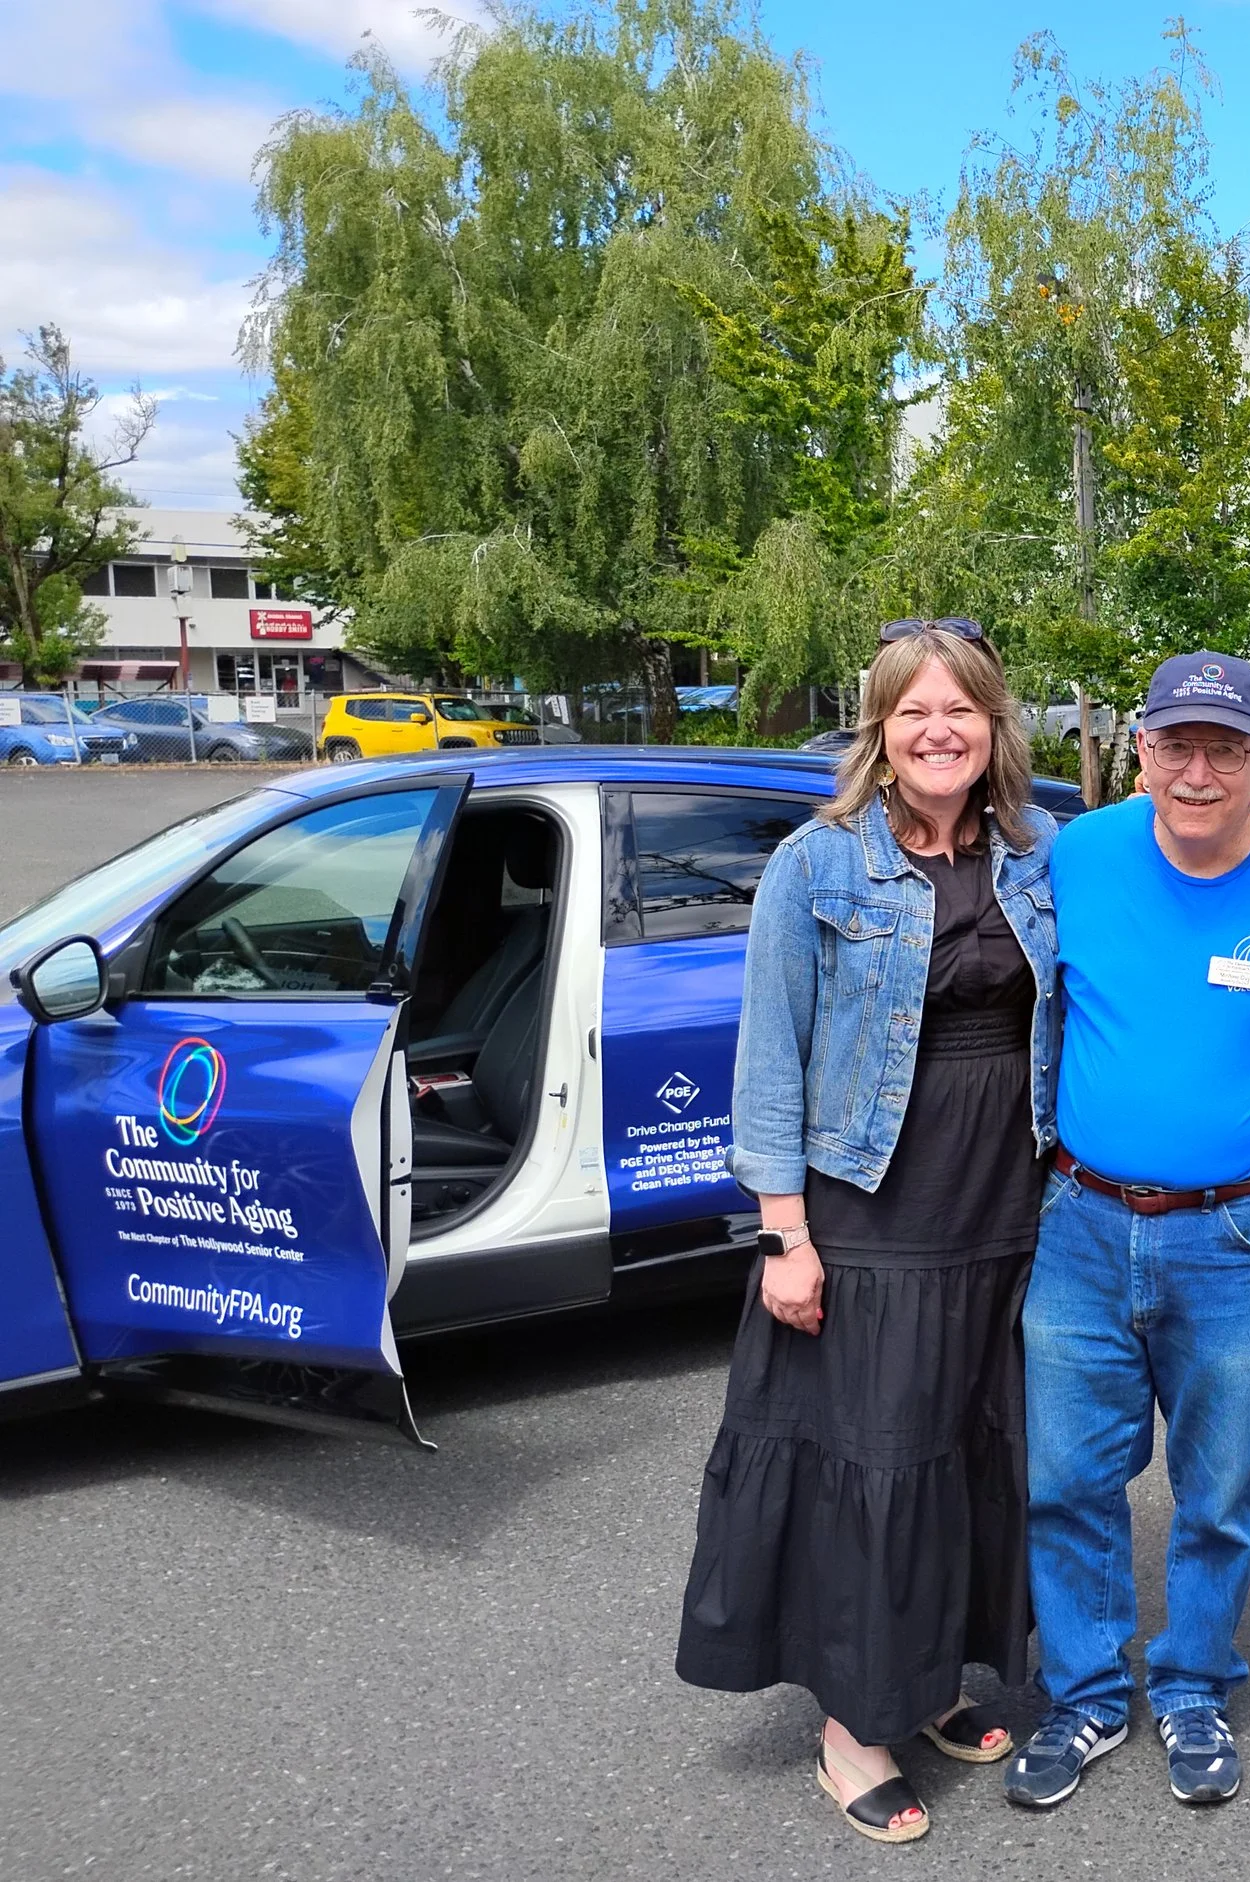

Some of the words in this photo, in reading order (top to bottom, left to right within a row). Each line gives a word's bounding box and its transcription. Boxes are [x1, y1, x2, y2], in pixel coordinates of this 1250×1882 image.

[1182, 680, 1224, 691] Community
[1223, 683, 1234, 692] for
[1188, 674, 1203, 682] The
[1192, 686, 1222, 696] Positive
[1222, 691, 1243, 703] Aging
[665, 1086, 692, 1099] PGE
[115, 1115, 159, 1148] The
[627, 1125, 658, 1138] Drive
[658, 1119, 702, 1133] Change
[703, 1114, 730, 1128] Fund
[640, 1139, 685, 1154] Powered
[688, 1137, 701, 1149] by
[702, 1135, 720, 1145] the
[620, 1157, 643, 1168] PGE
[645, 1153, 673, 1166] Drive
[675, 1149, 714, 1162] Change
[716, 1145, 728, 1155] Fu
[105, 1148, 227, 1194] Community
[231, 1160, 260, 1196] for
[636, 1167, 656, 1179] and
[658, 1162, 690, 1175] DEQ's
[692, 1158, 724, 1171] Orego
[631, 1178, 662, 1191] Clean
[664, 1174, 691, 1187] Fuels
[694, 1169, 733, 1183] Progra
[105, 1187, 133, 1199] SINCE
[115, 1200, 137, 1211] 1973
[137, 1187, 226, 1223] Positive
[229, 1196, 299, 1239] Aging
[118, 1230, 131, 1241] The
[131, 1231, 146, 1242] Next
[146, 1233, 172, 1245] Chapter
[171, 1235, 180, 1247] of
[179, 1234, 198, 1247] The
[197, 1236, 245, 1254] Hollywood
[244, 1241, 273, 1257] Senior
[273, 1246, 305, 1261] Center
[127, 1273, 304, 1339] CommunityFPA.org
